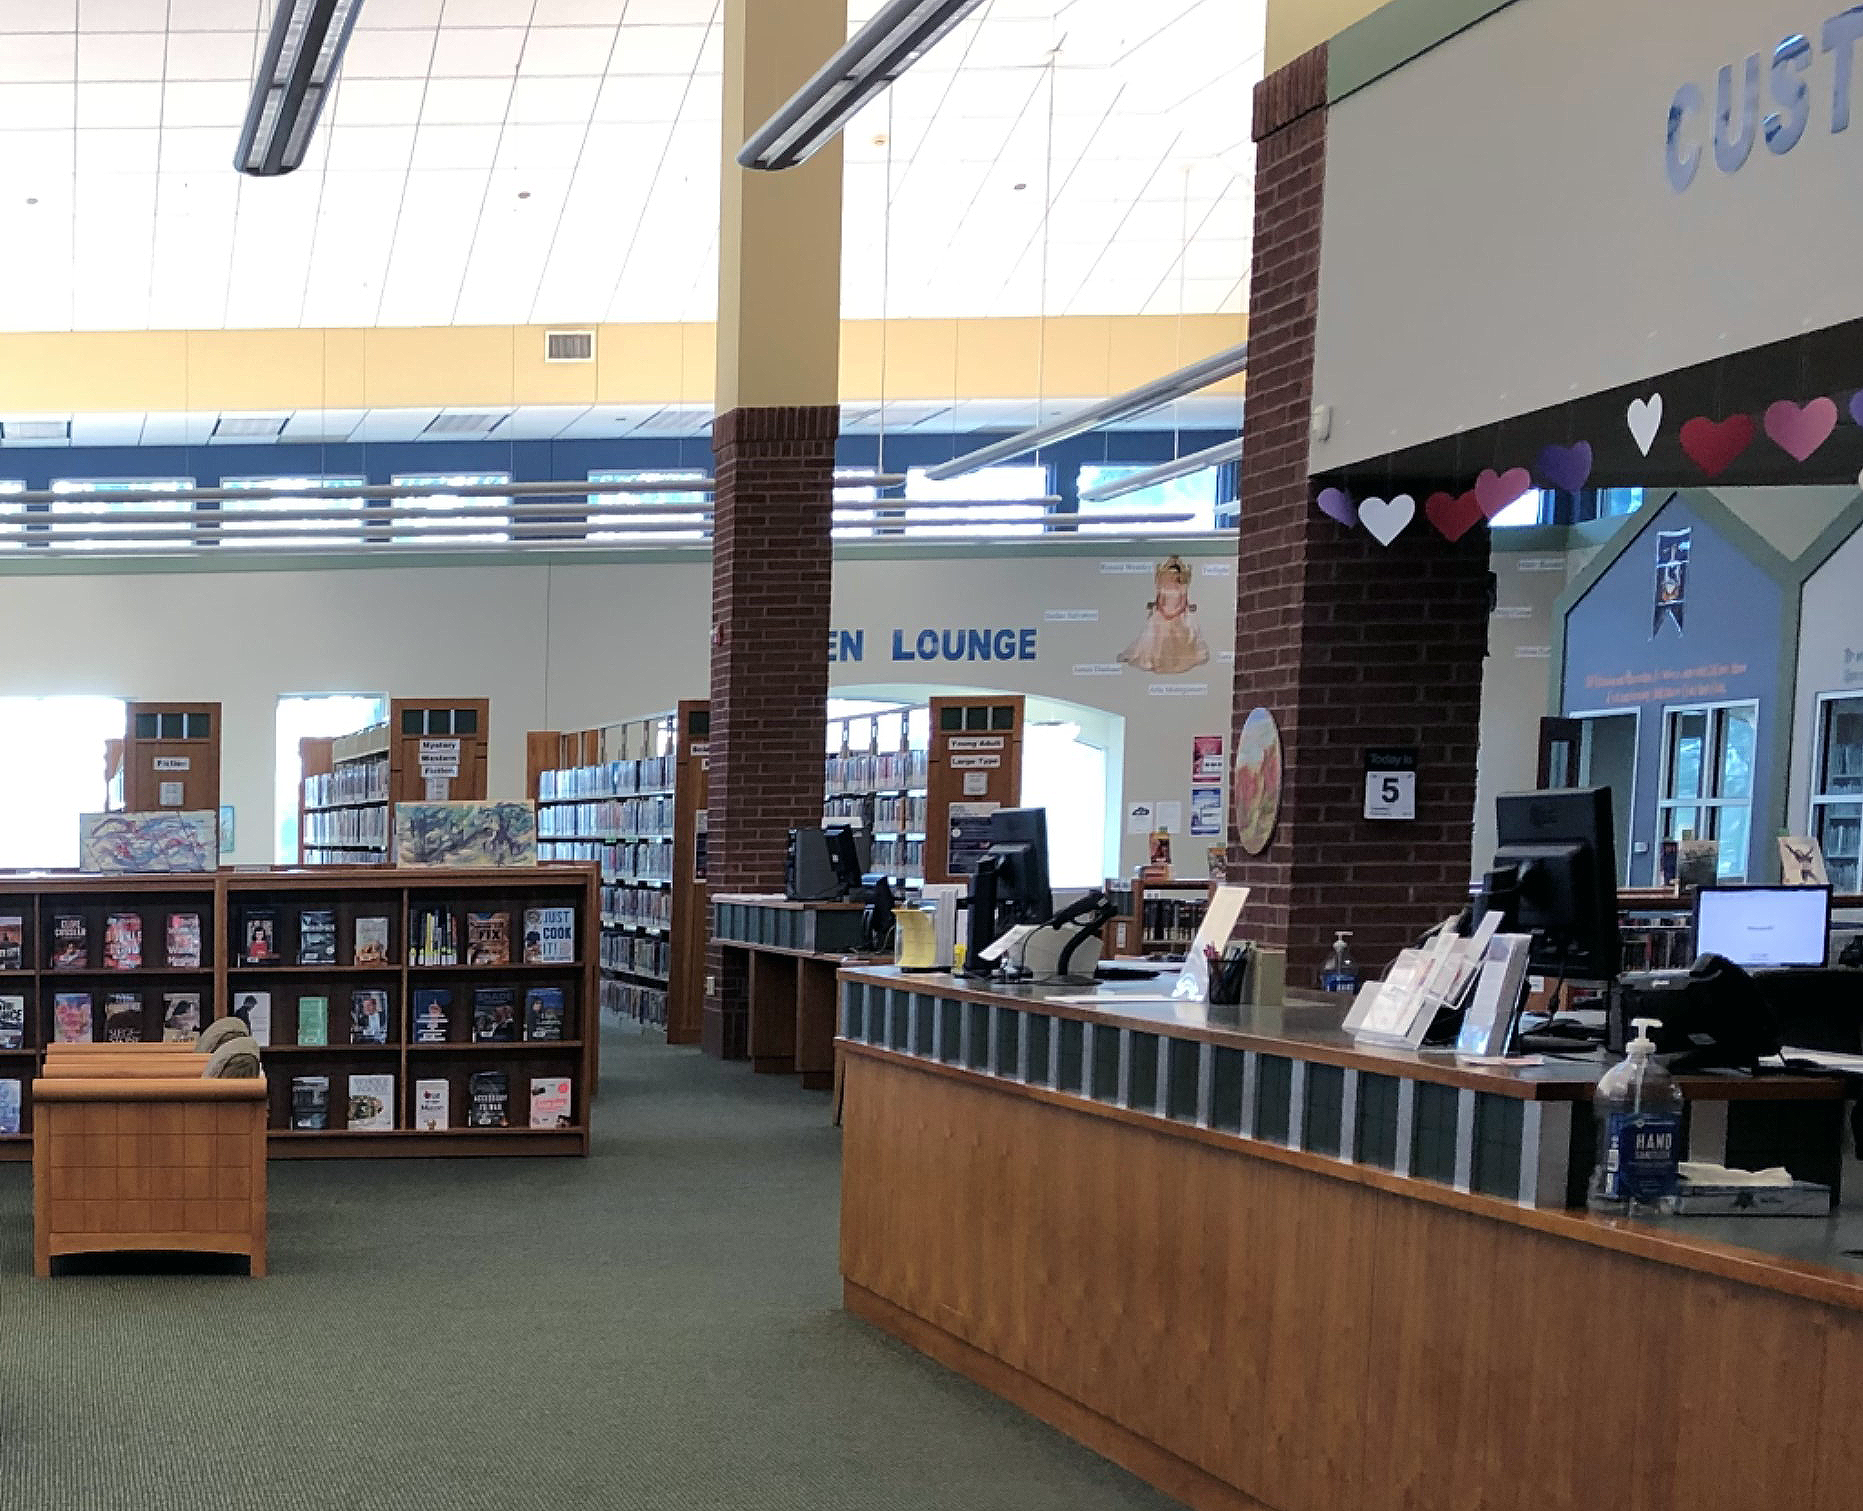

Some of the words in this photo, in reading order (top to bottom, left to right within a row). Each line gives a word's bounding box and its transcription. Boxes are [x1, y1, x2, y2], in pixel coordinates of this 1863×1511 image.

[1665, 4, 1863, 196] CUST
[828, 628, 864, 662] EN
[892, 628, 1036, 662] LOUNGE
[1382, 778, 1399, 803] 5
[544, 911, 570, 923] JUST
[479, 928, 501, 940] FIX
[543, 927, 572, 940] COOK
[1636, 1132, 1672, 1150] HAND
